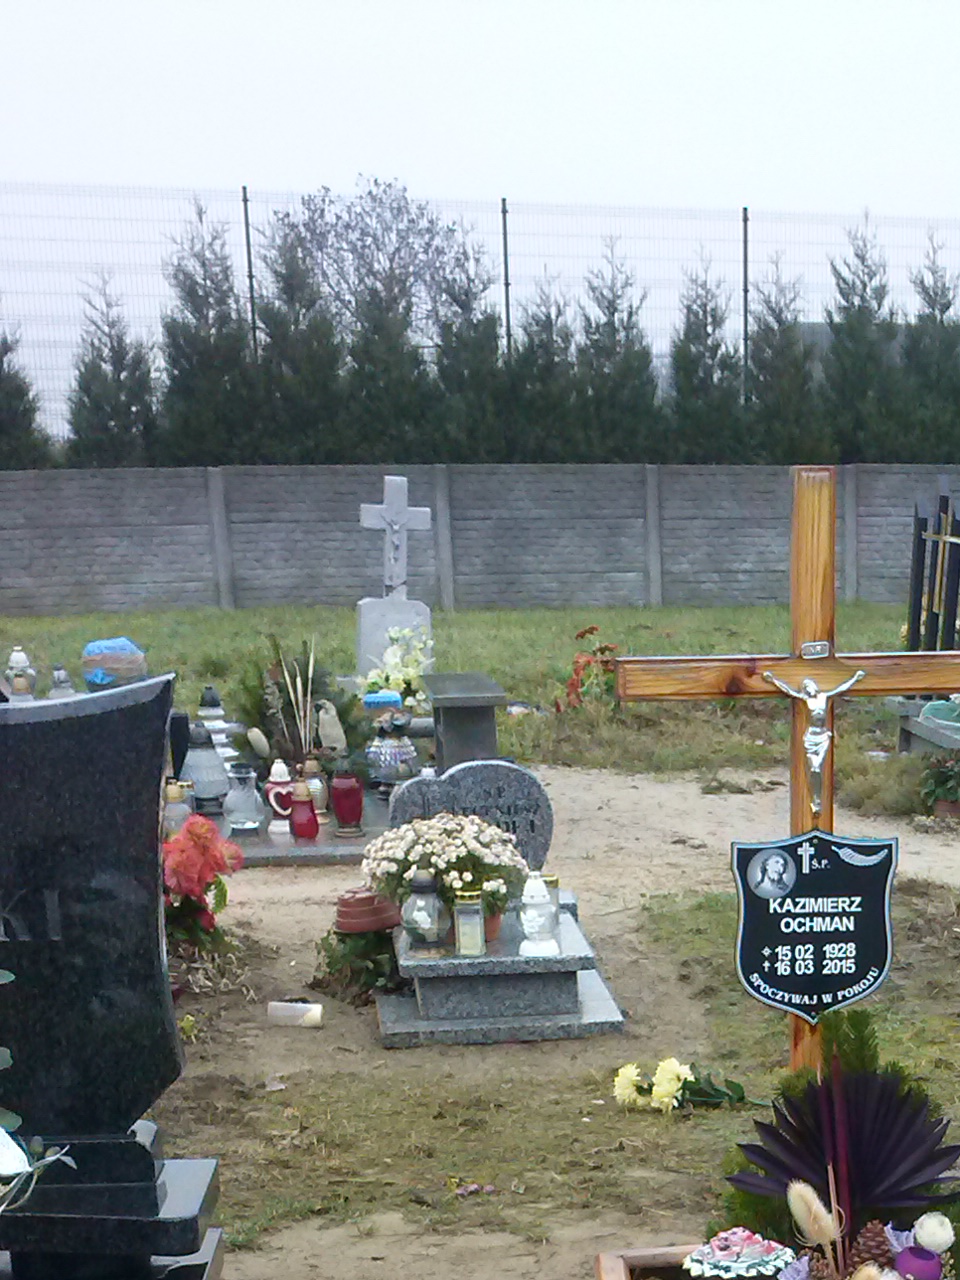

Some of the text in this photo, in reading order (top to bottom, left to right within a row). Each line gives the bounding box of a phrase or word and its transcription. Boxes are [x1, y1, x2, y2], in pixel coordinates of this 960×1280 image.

[769, 896, 862, 913] KAZIMIERZ
[780, 916, 855, 933] OCHMAN
[774, 943, 856, 960] 15 02 1928
[774, 959, 856, 976] 16 03 2015
[749, 966, 880, 1005] SPOCZYWAJ W POKOJU
